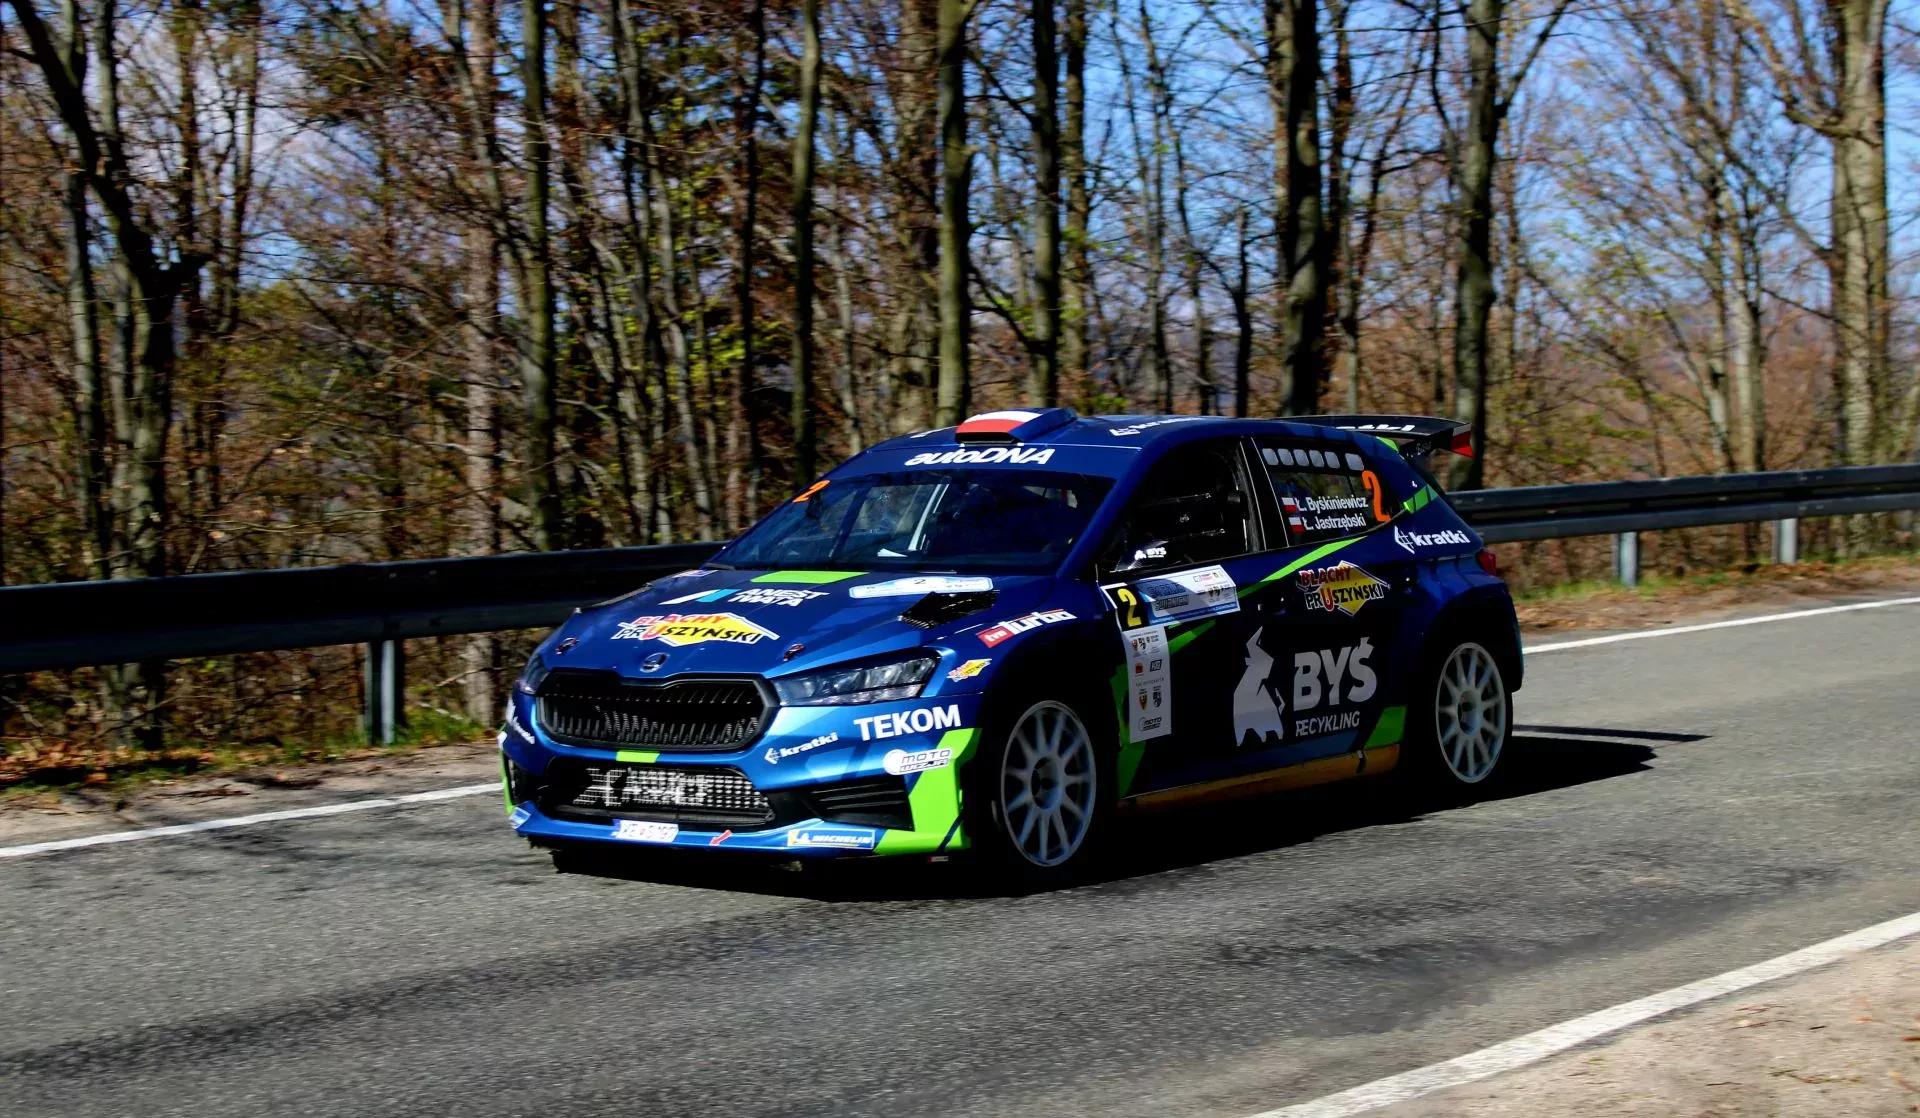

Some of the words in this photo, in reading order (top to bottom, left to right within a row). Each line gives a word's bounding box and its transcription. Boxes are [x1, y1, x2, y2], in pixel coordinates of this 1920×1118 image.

[904, 447, 1055, 466] autoDNA
[792, 480, 831, 503] 2
[1361, 470, 1392, 523] 2
[1307, 495, 1369, 514] Byśkiniewicz
[1315, 513, 1367, 532] Jastrzębski
[1408, 530, 1471, 547] kratki
[1300, 566, 1352, 586] BLACHY
[1304, 582, 1384, 611] PRUSZYŃSKI
[1117, 588, 1142, 628] 2
[632, 613, 730, 626] BLACHY
[614, 624, 764, 644] PRUSZYŃSKI
[1293, 636, 1377, 712] BYŚ
[853, 704, 962, 741] TEKOM
[1295, 710, 1361, 737] RECYKLING
[779, 732, 839, 757] kratki
[812, 834, 873, 844] MICHELIN
